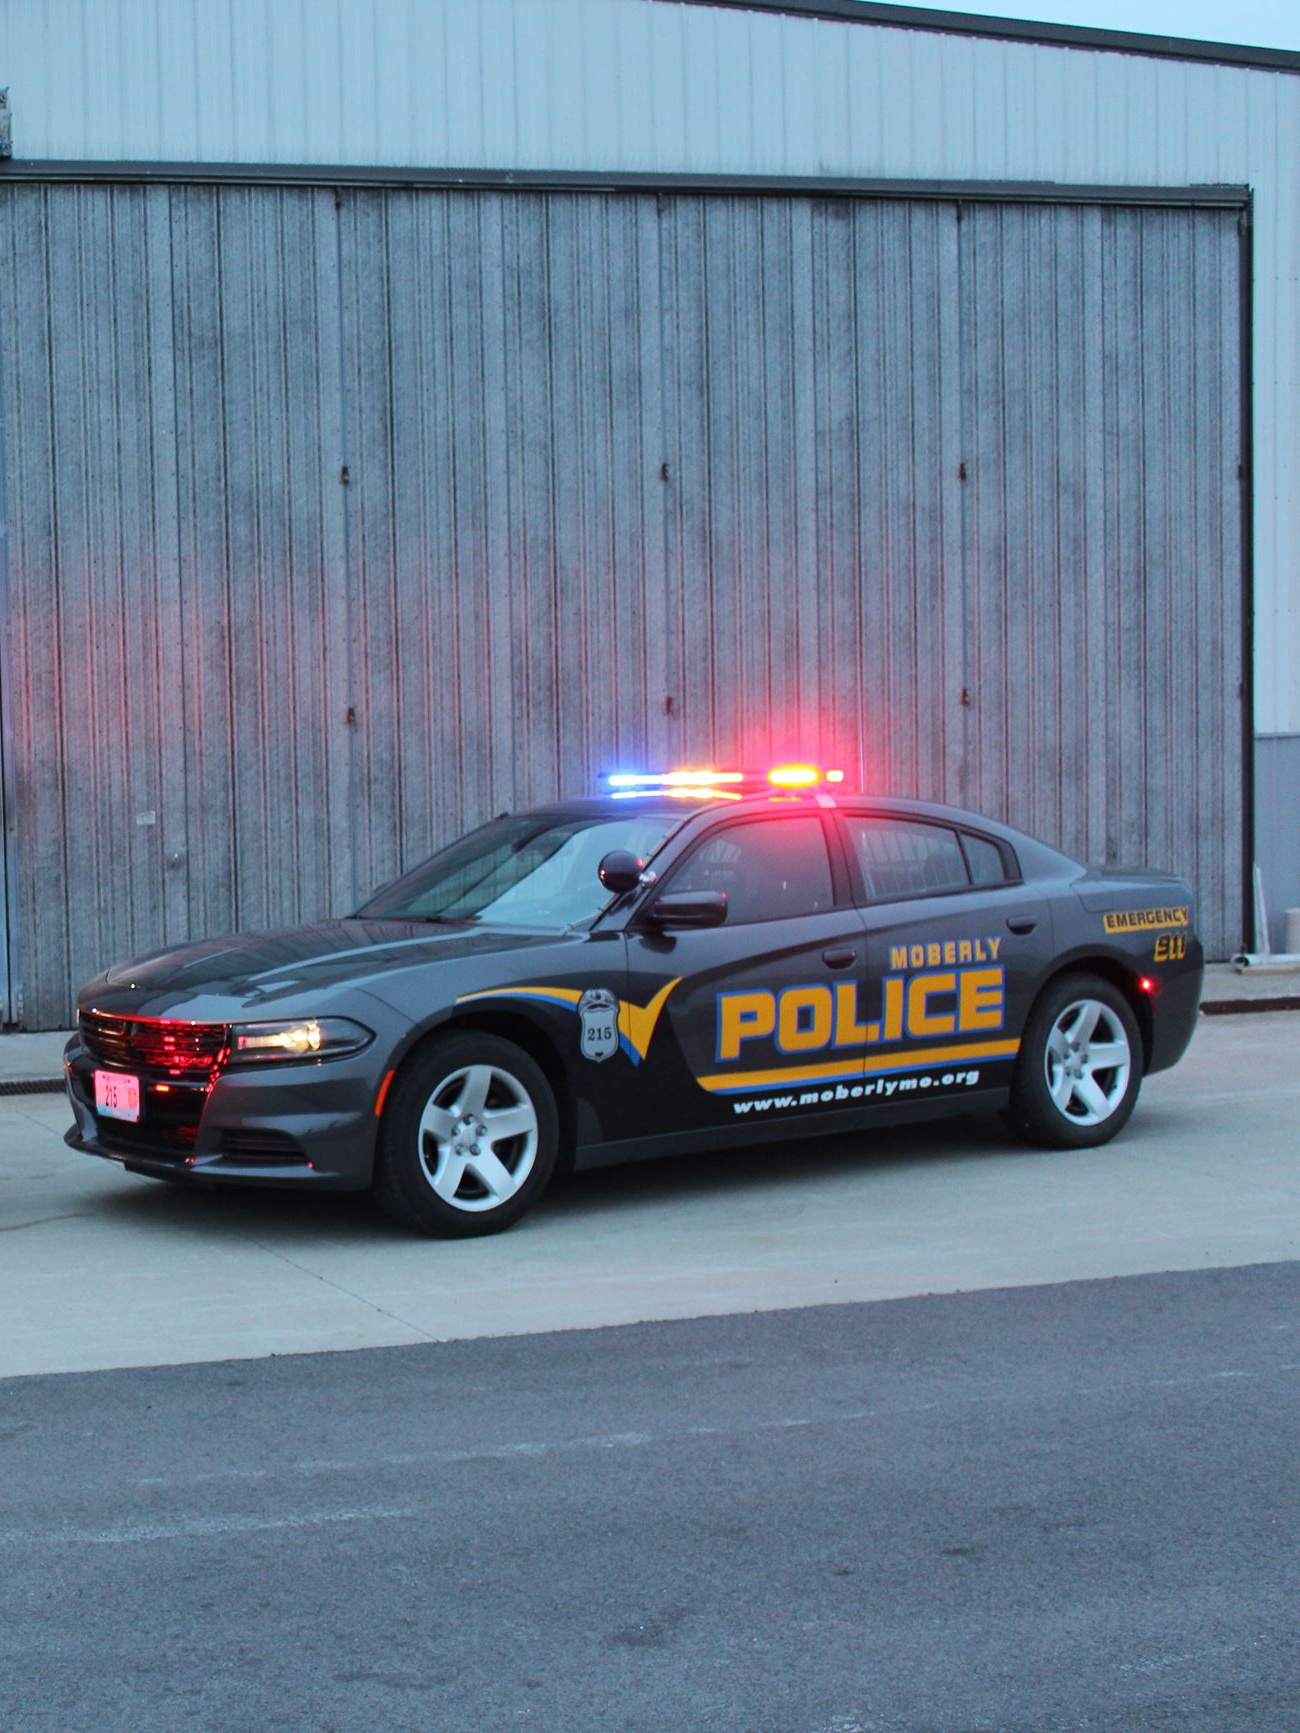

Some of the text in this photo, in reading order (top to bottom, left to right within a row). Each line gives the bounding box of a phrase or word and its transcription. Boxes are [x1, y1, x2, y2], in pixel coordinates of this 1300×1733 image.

[1104, 907, 1188, 930] EMERGENCY
[890, 937, 1001, 970] MOBERLY
[1155, 932, 1186, 960] 911
[716, 964, 1004, 1062] POLICE
[588, 1026, 612, 1041] 215
[733, 1070, 980, 1114] www.moberlymo.org
